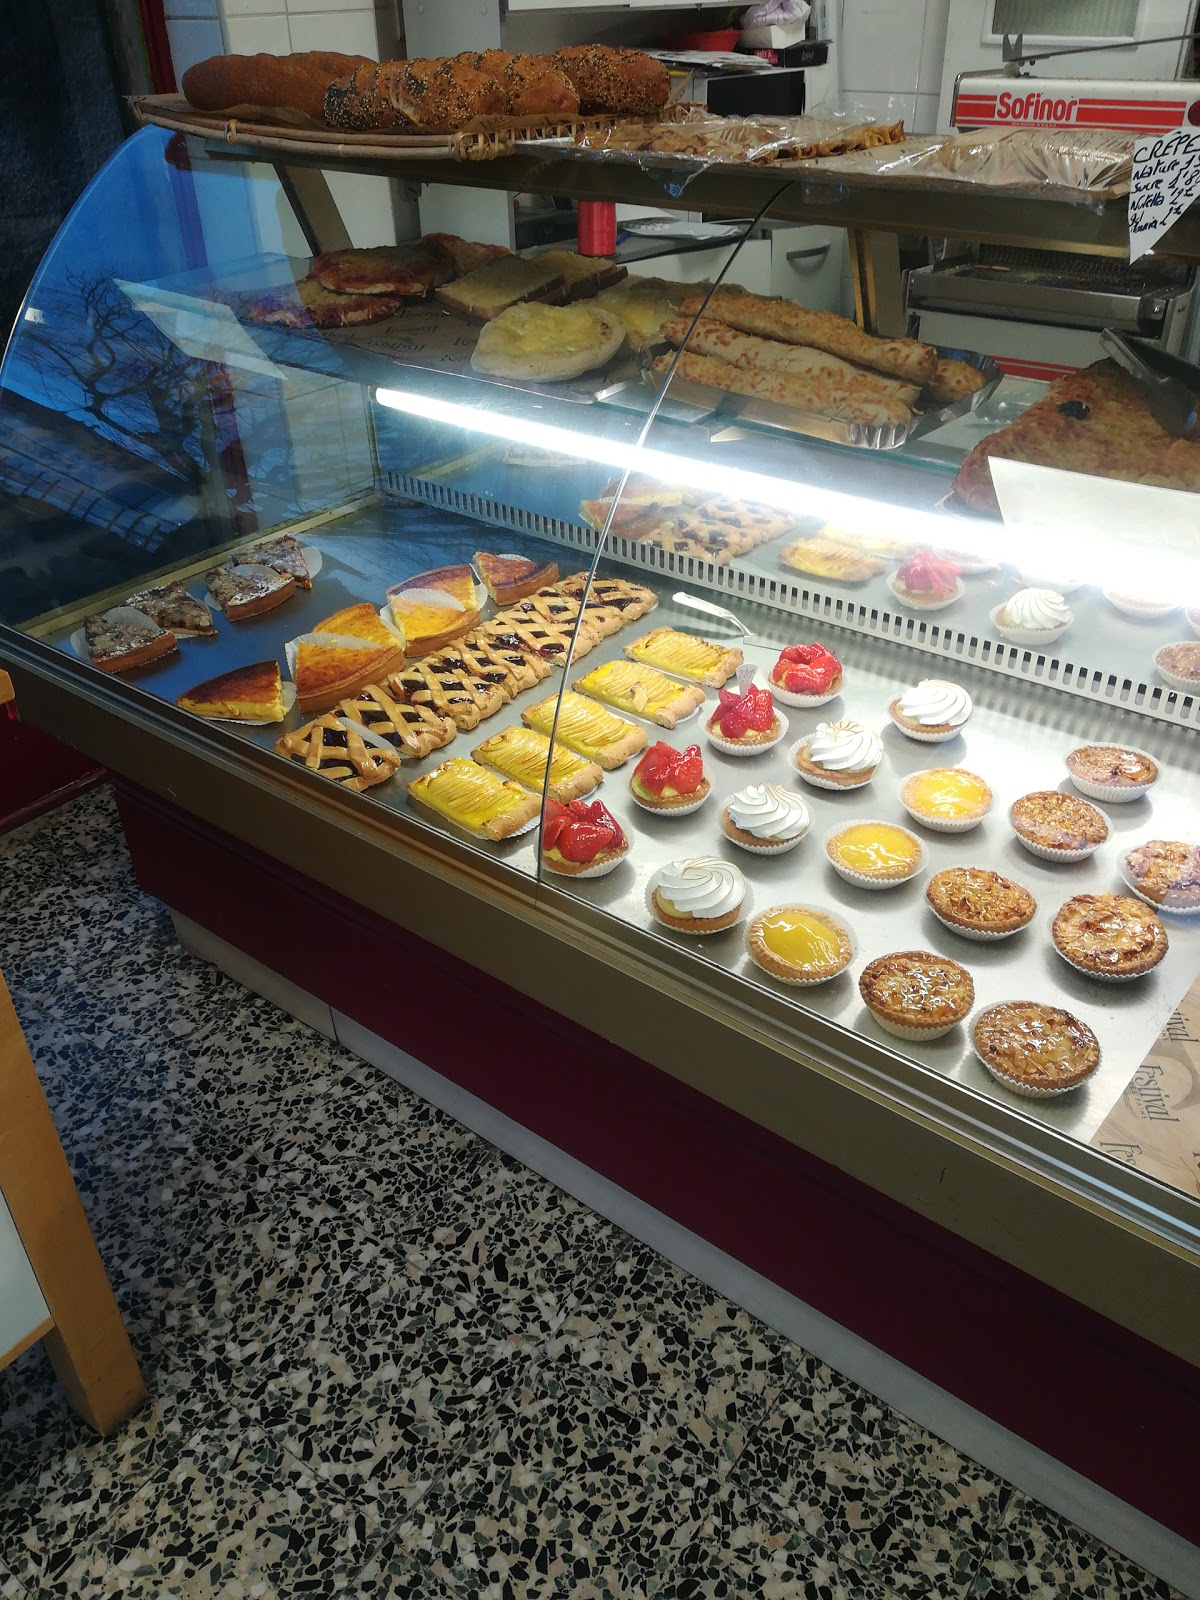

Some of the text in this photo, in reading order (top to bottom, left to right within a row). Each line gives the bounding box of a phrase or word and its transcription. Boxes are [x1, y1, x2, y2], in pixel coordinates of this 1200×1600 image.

[997, 92, 1078, 121] Sofinor
[1132, 159, 1180, 181] Nature
[1130, 179, 1164, 194] Sucre
[1130, 191, 1165, 211] Nutella
[1134, 1064, 1181, 1122] Festival
